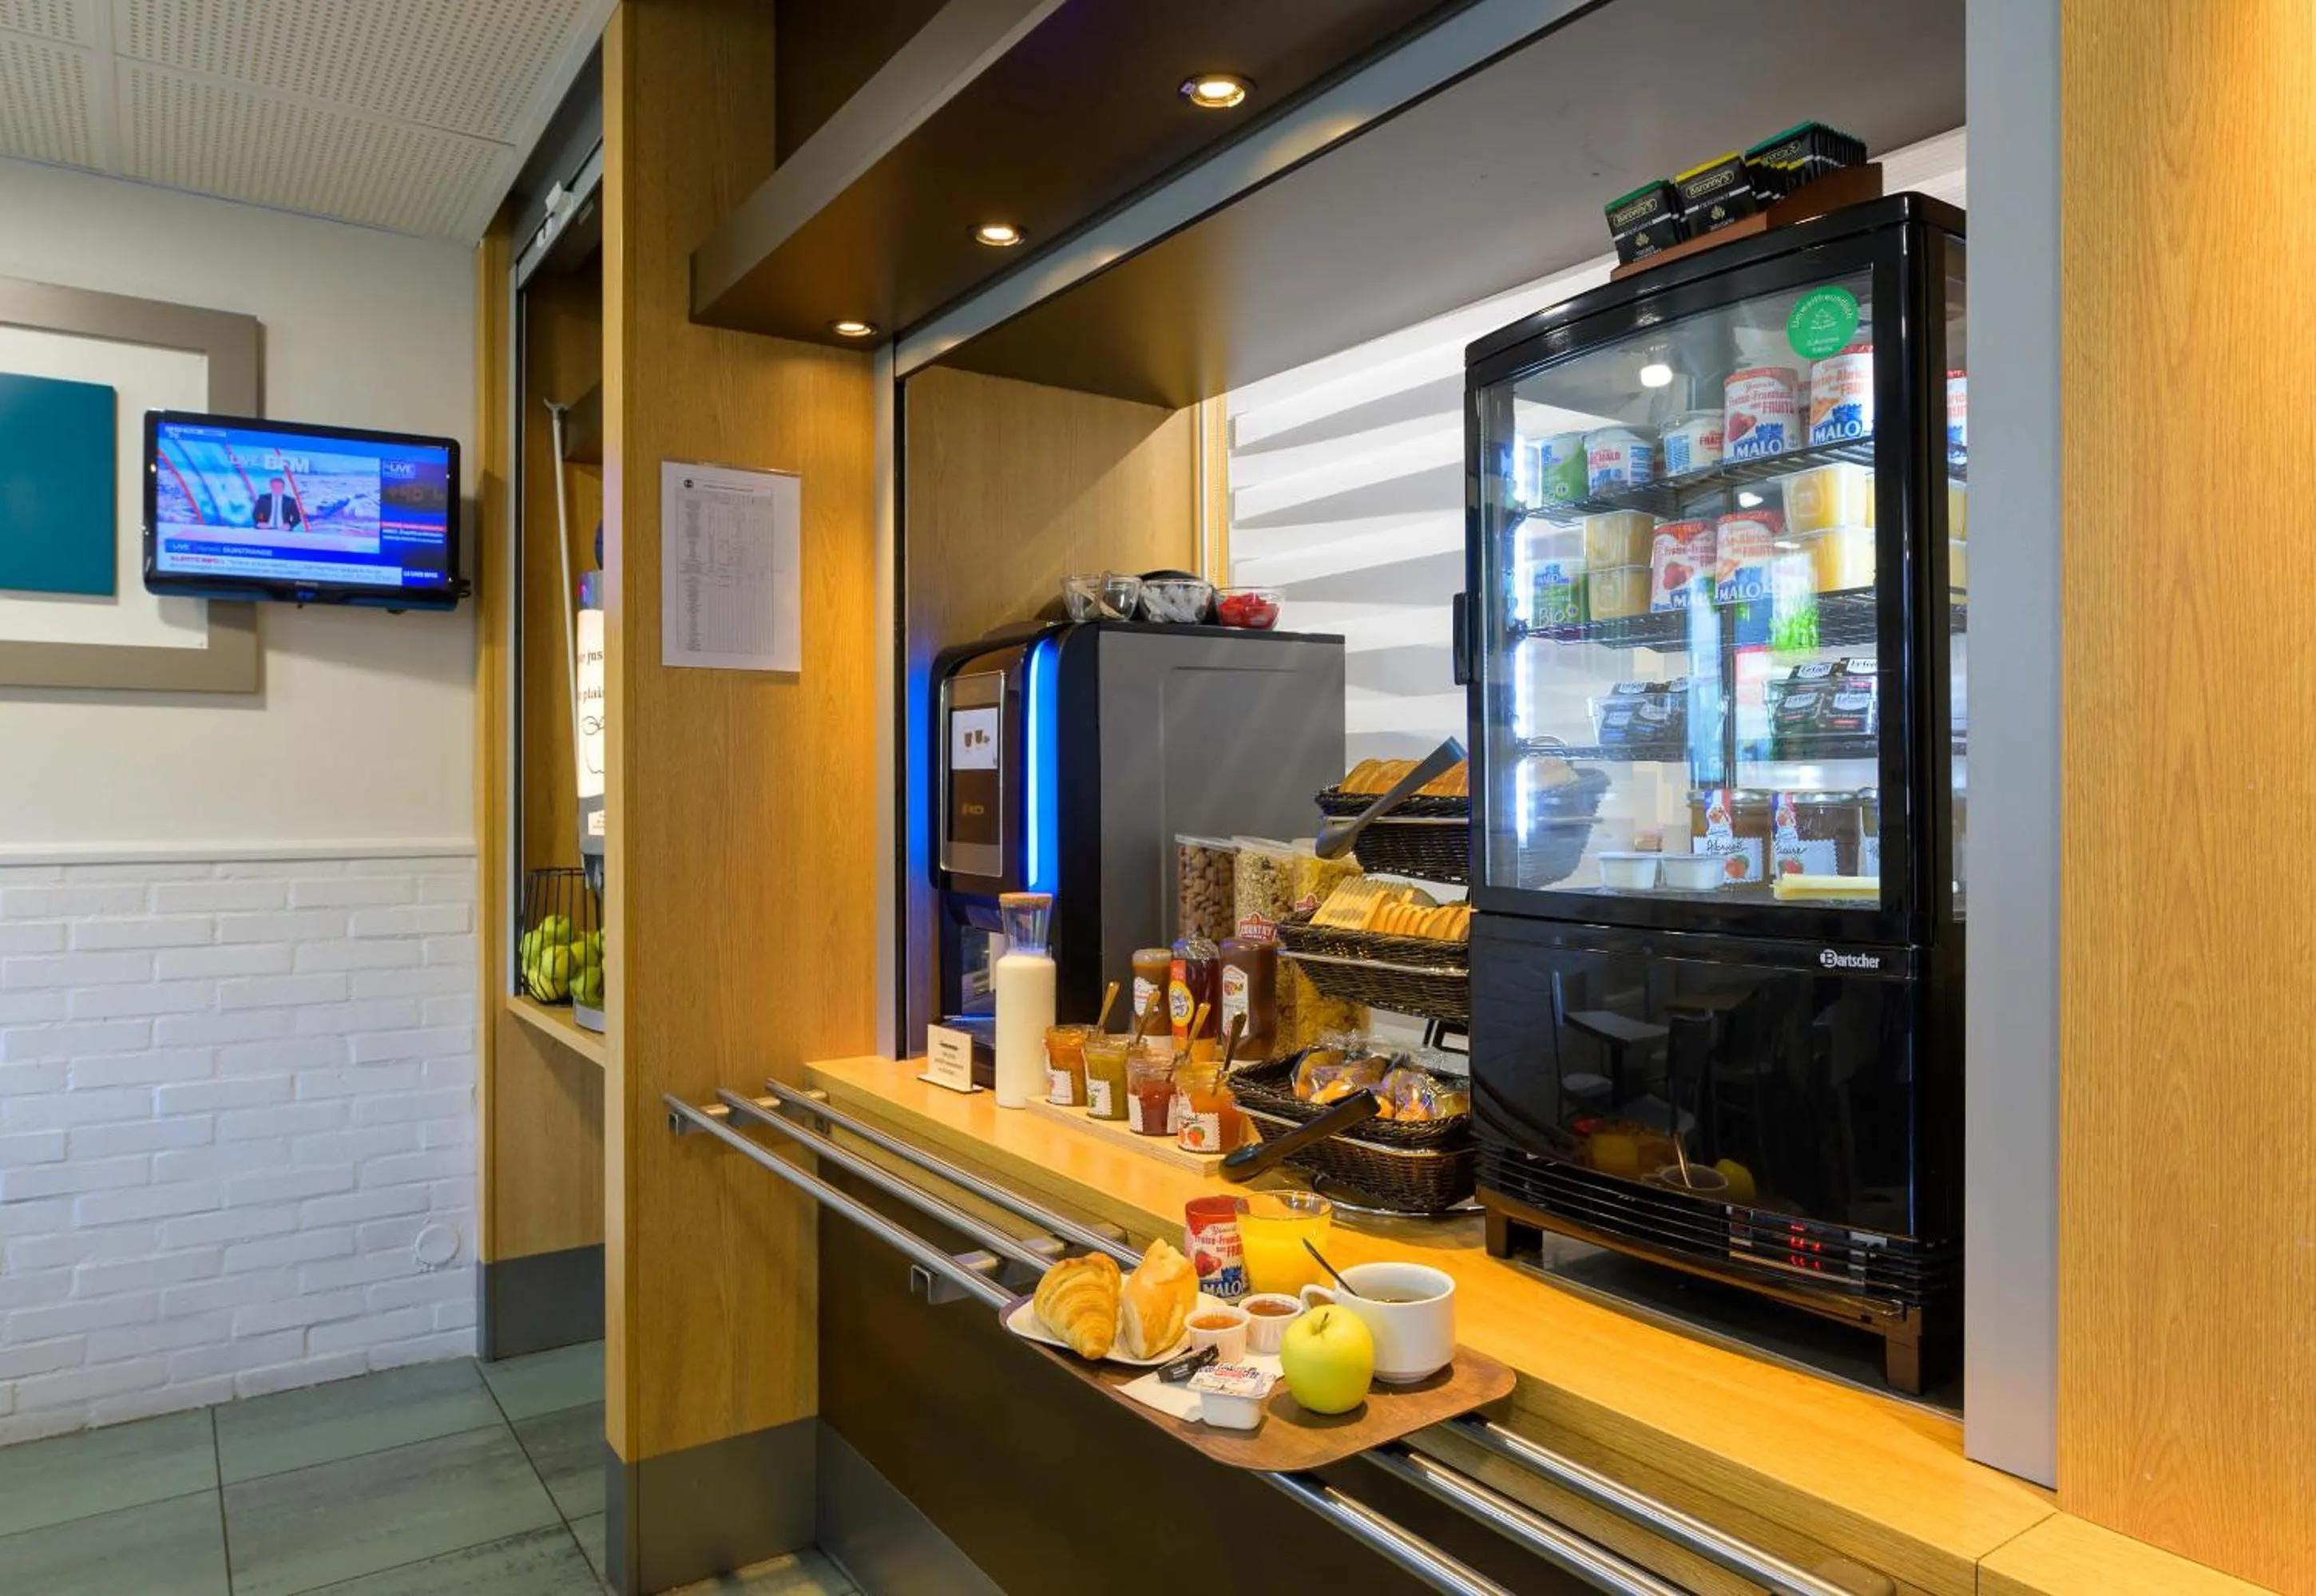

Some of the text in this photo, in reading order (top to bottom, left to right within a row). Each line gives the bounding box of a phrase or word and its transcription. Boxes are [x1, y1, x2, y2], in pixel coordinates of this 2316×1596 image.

[1814, 420, 1862, 445] MALO
[1736, 438, 1783, 460] MALO
[1719, 583, 1762, 602] MALO
[1820, 948, 1880, 968] Bartscher
[1202, 1279, 1243, 1297] MALO
